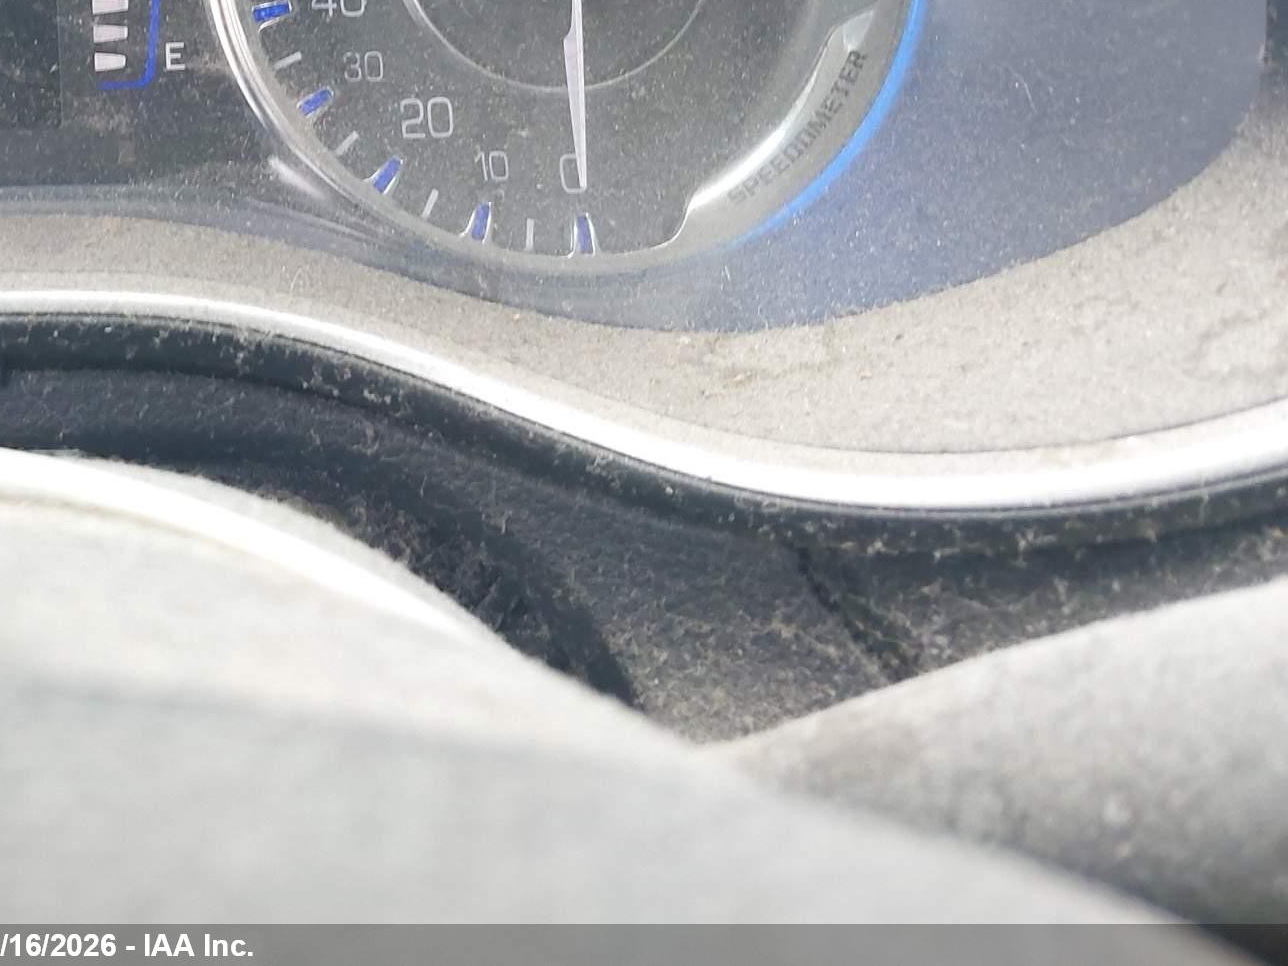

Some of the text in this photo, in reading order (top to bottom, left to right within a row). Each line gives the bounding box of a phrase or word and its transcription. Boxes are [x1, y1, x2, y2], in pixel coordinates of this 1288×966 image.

[166, 43, 185, 71] E
[344, 53, 384, 81] 30
[401, 98, 454, 139] 20
[728, 49, 868, 204] SPEEDOMETER
[474, 151, 509, 180] 10
[560, 153, 585, 193] 0
